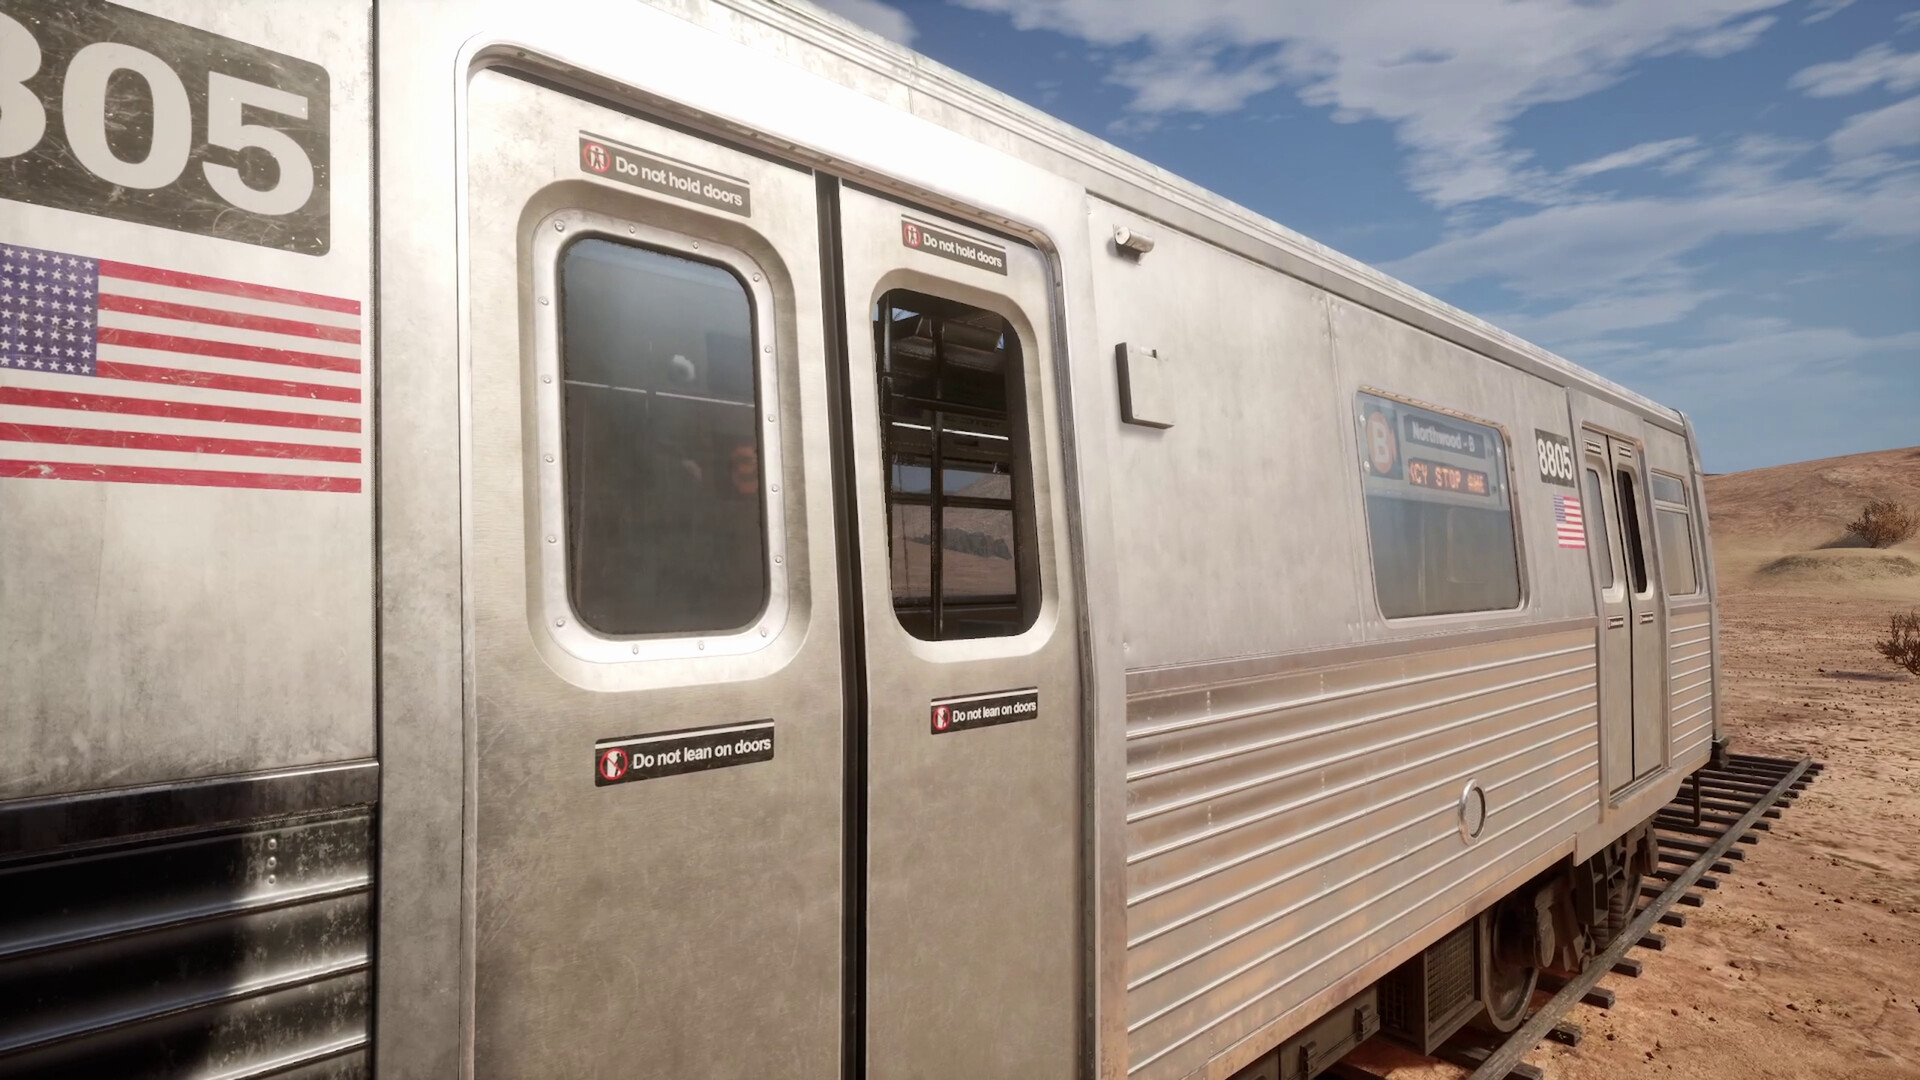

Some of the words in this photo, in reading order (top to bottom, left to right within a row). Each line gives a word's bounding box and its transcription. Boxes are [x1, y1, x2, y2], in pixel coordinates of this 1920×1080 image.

[615, 155, 638, 176] Do
[642, 167, 666, 185] not
[669, 172, 701, 194] hold
[703, 183, 743, 206] doors
[923, 233, 938, 248] Do
[939, 241, 955, 254] not
[955, 243, 976, 260] hold
[977, 251, 1002, 267] doors
[1372, 421, 1389, 463] B
[1412, 421, 1462, 449] Northwood
[1537, 438, 1572, 480] 8805
[1435, 466, 1461, 489] STOP
[952, 710, 966, 722] Do
[967, 708, 982, 720] not
[983, 706, 1000, 718] lean
[1001, 706, 1013, 715] on
[1013, 701, 1037, 714] doors
[633, 753, 655, 769] Do
[657, 750, 681, 766] not
[683, 746, 712, 762] lean
[714, 744, 732, 757] on
[735, 738, 772, 755] doors
